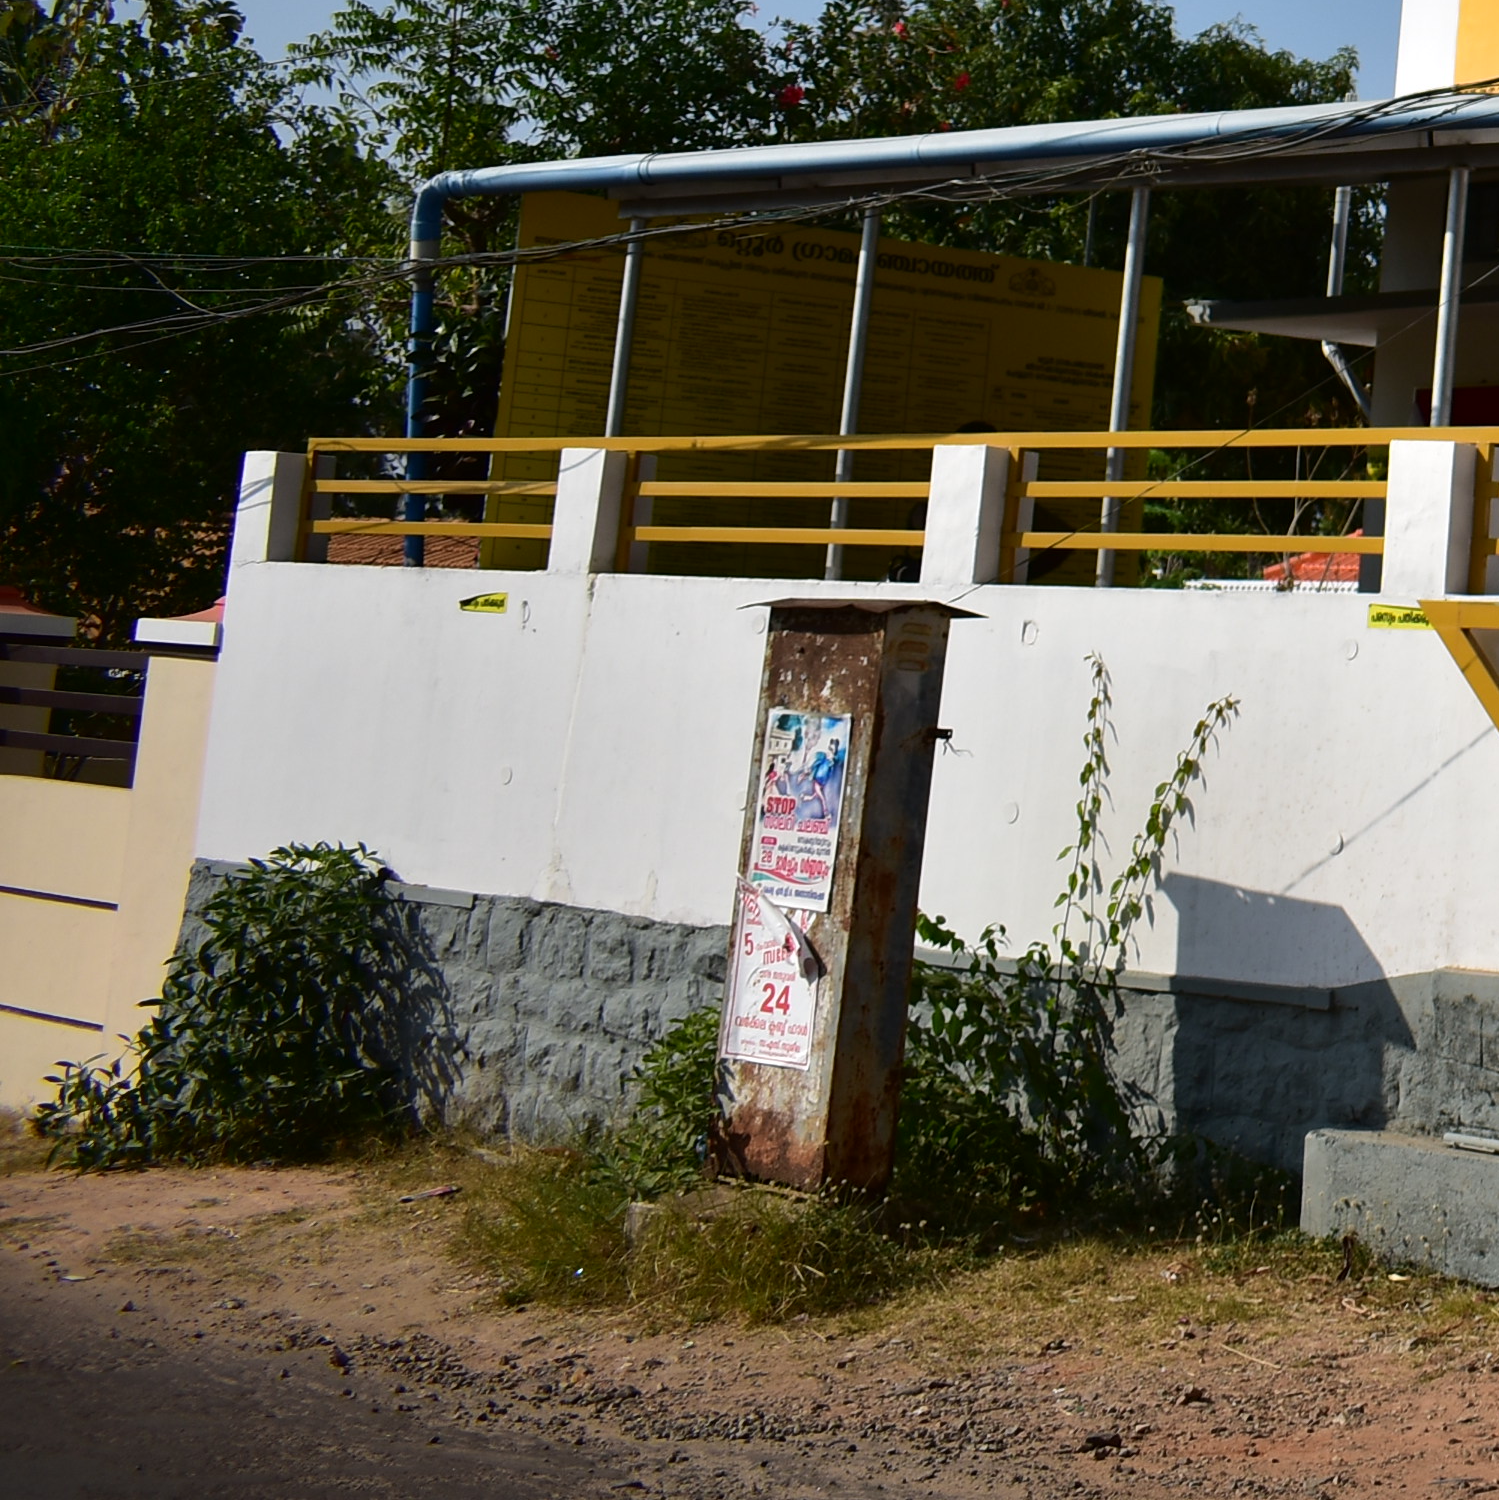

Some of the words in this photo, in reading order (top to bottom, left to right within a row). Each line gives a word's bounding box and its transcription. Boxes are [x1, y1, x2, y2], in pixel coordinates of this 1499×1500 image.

[792, 241, 1000, 283] ഗ്രാമഞ്ചായത്ത്
[766, 796, 796, 815] STOP
[760, 982, 791, 1016] 24
